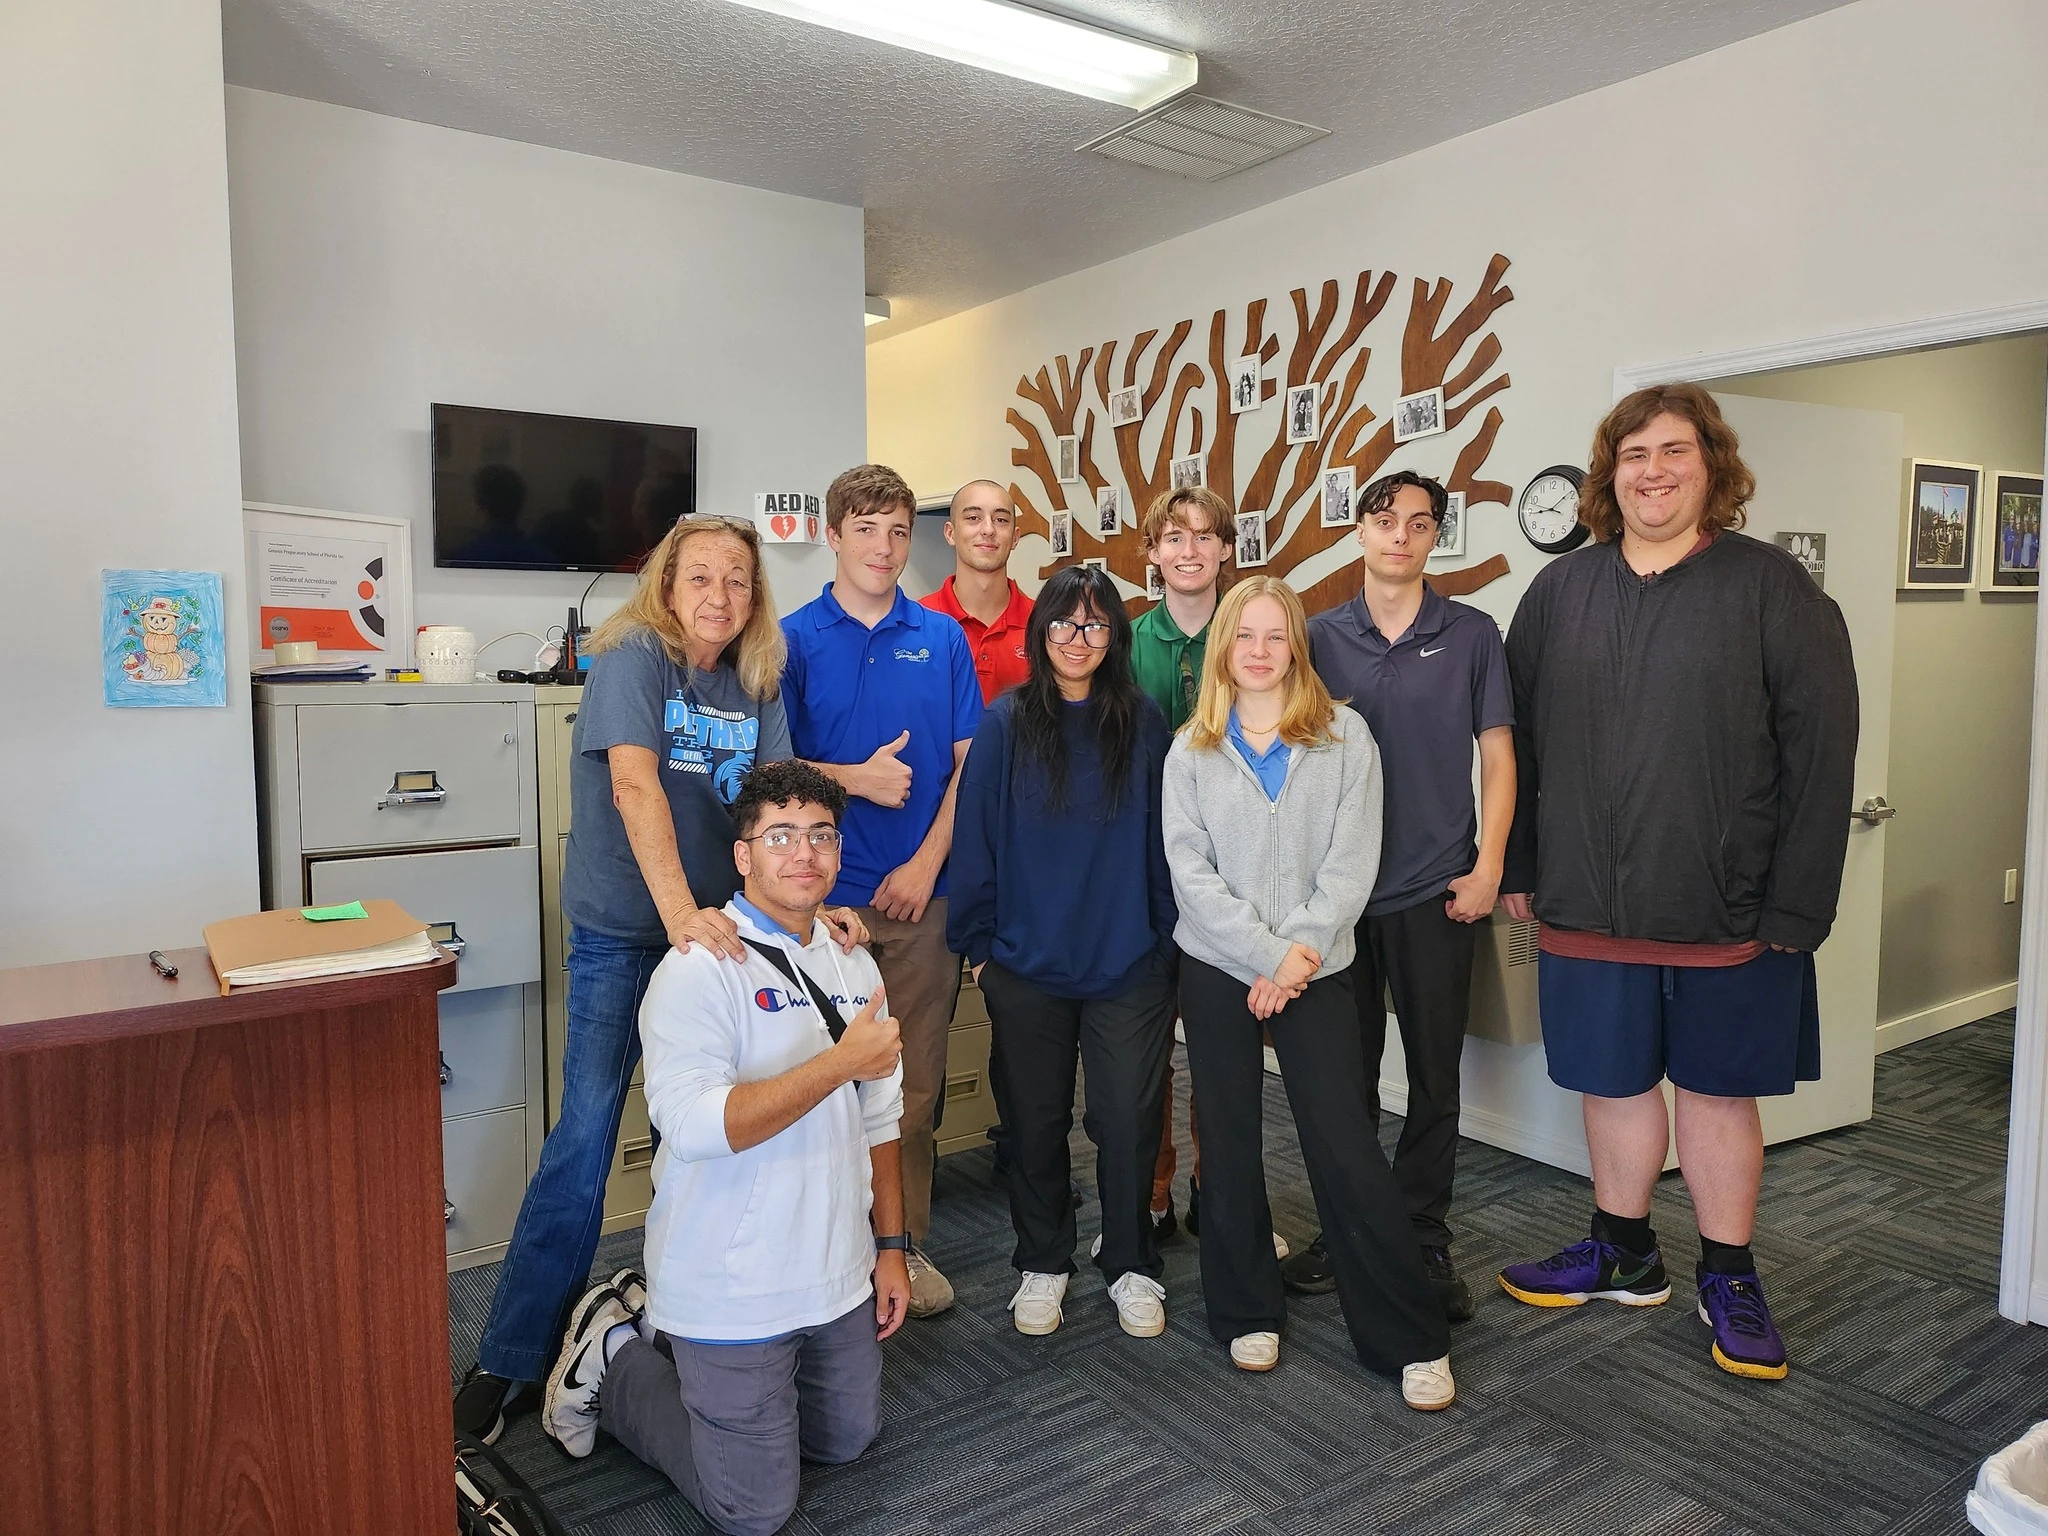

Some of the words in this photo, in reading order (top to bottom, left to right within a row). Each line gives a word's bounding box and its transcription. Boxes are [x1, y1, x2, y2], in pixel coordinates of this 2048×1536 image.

[1540, 485, 1545, 494] 11
[1549, 480, 1557, 490] 12
[1530, 495, 1539, 505] 10
[1570, 490, 1576, 500] 2
[765, 494, 801, 512] AED
[805, 495, 819, 514] AED
[1527, 507, 1533, 517] 9
[1569, 515, 1575, 524] 4
[1531, 521, 1537, 530] 8
[1561, 525, 1567, 535] 5
[1540, 528, 1546, 537] 7
[1550, 530, 1556, 539] 6
